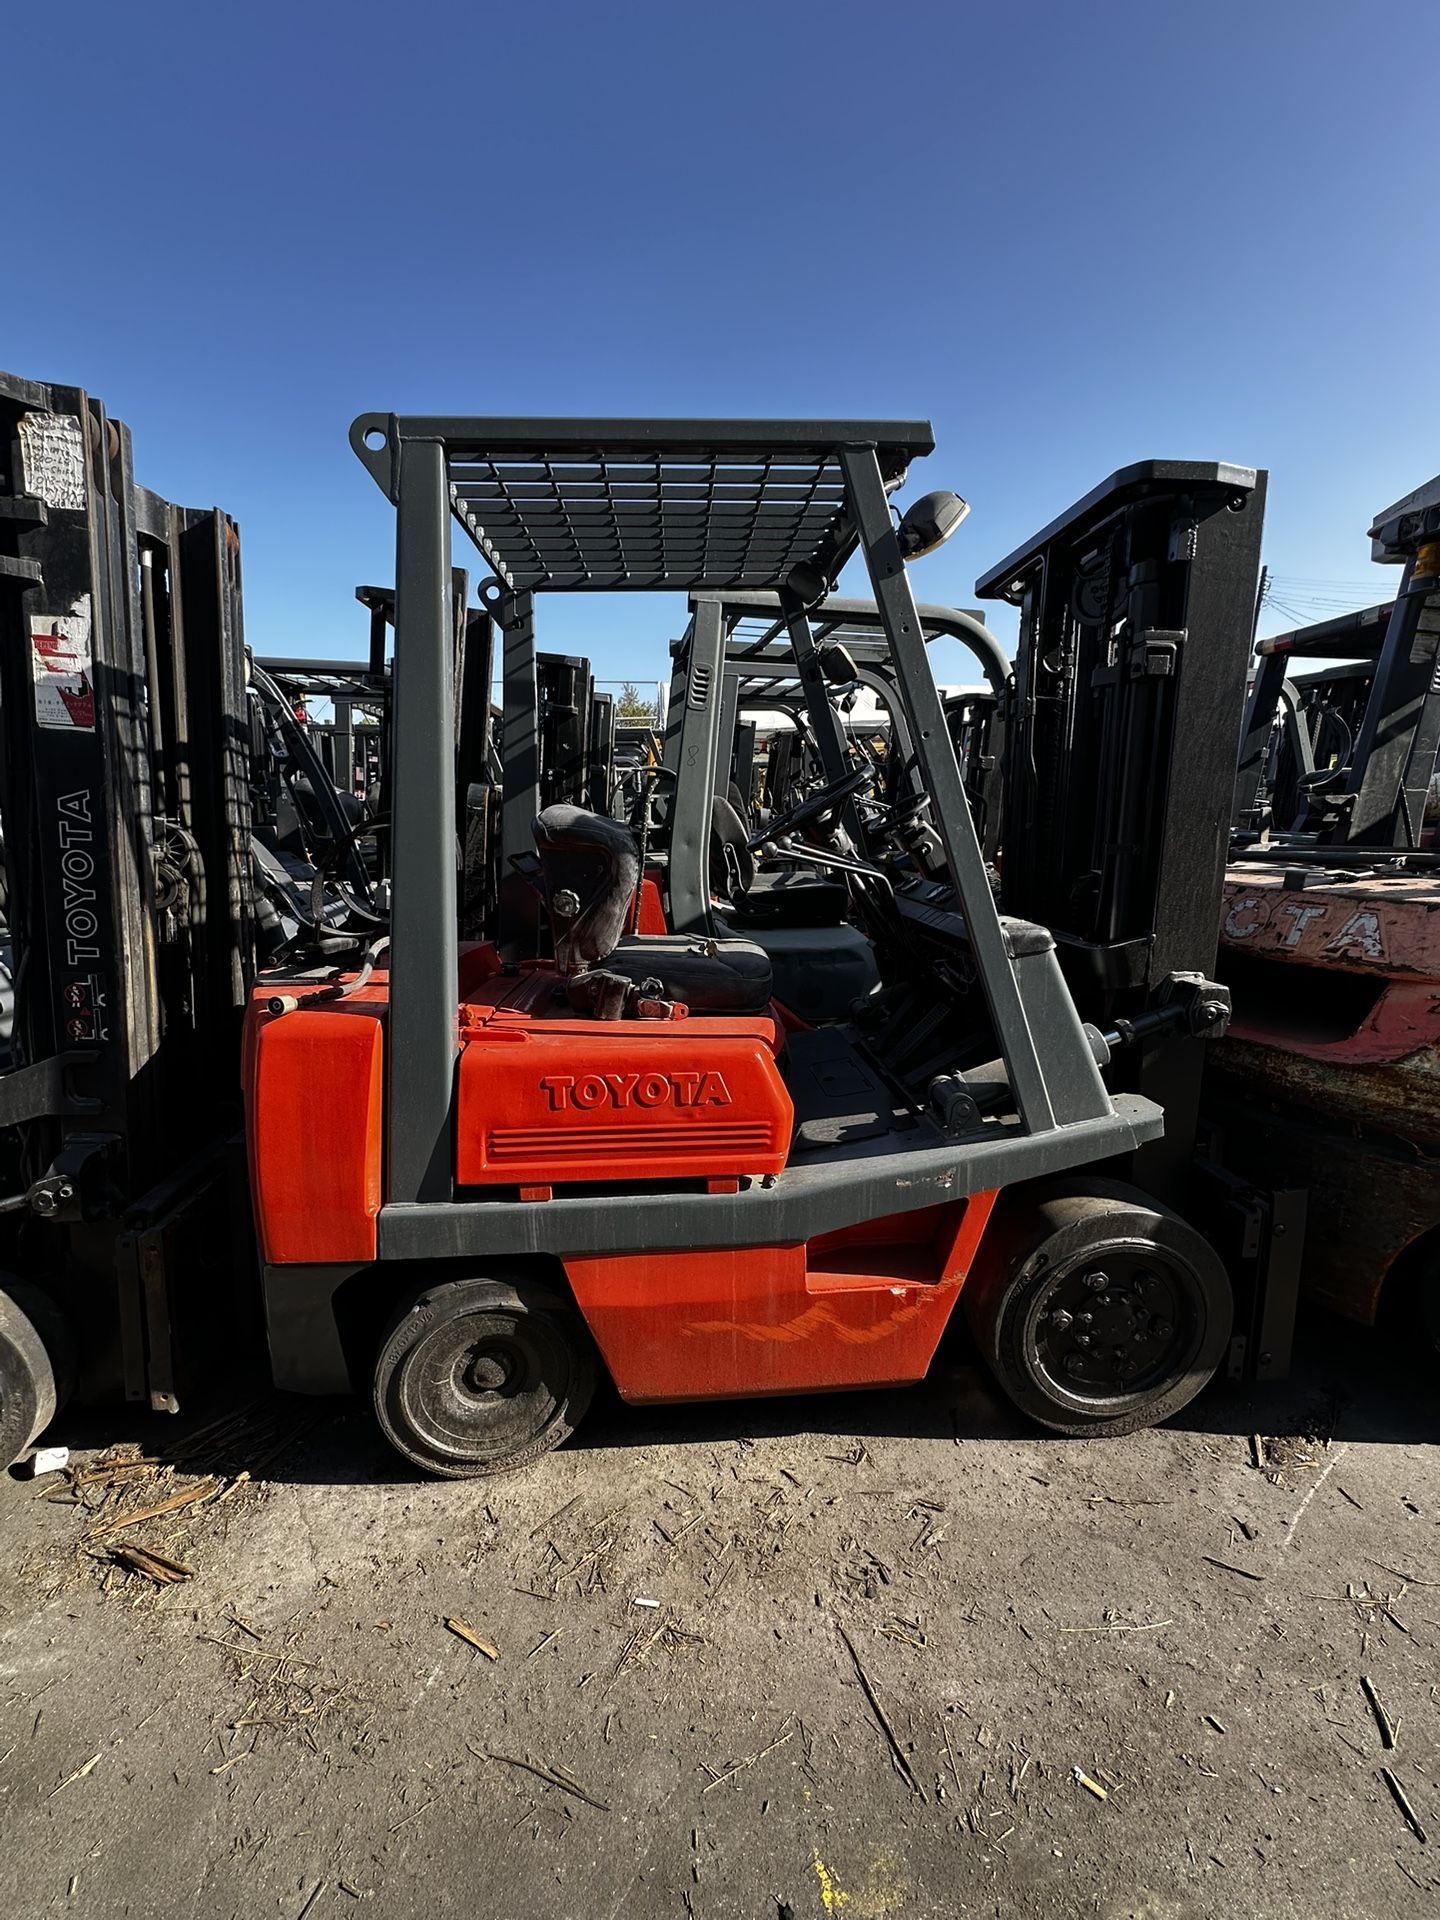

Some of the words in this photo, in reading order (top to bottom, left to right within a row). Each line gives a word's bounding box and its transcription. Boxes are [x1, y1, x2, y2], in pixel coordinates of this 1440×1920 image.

[687, 745, 699, 766] 8
[57, 788, 100, 966] TOYOTA
[540, 1071, 733, 1112] TOYOTA
